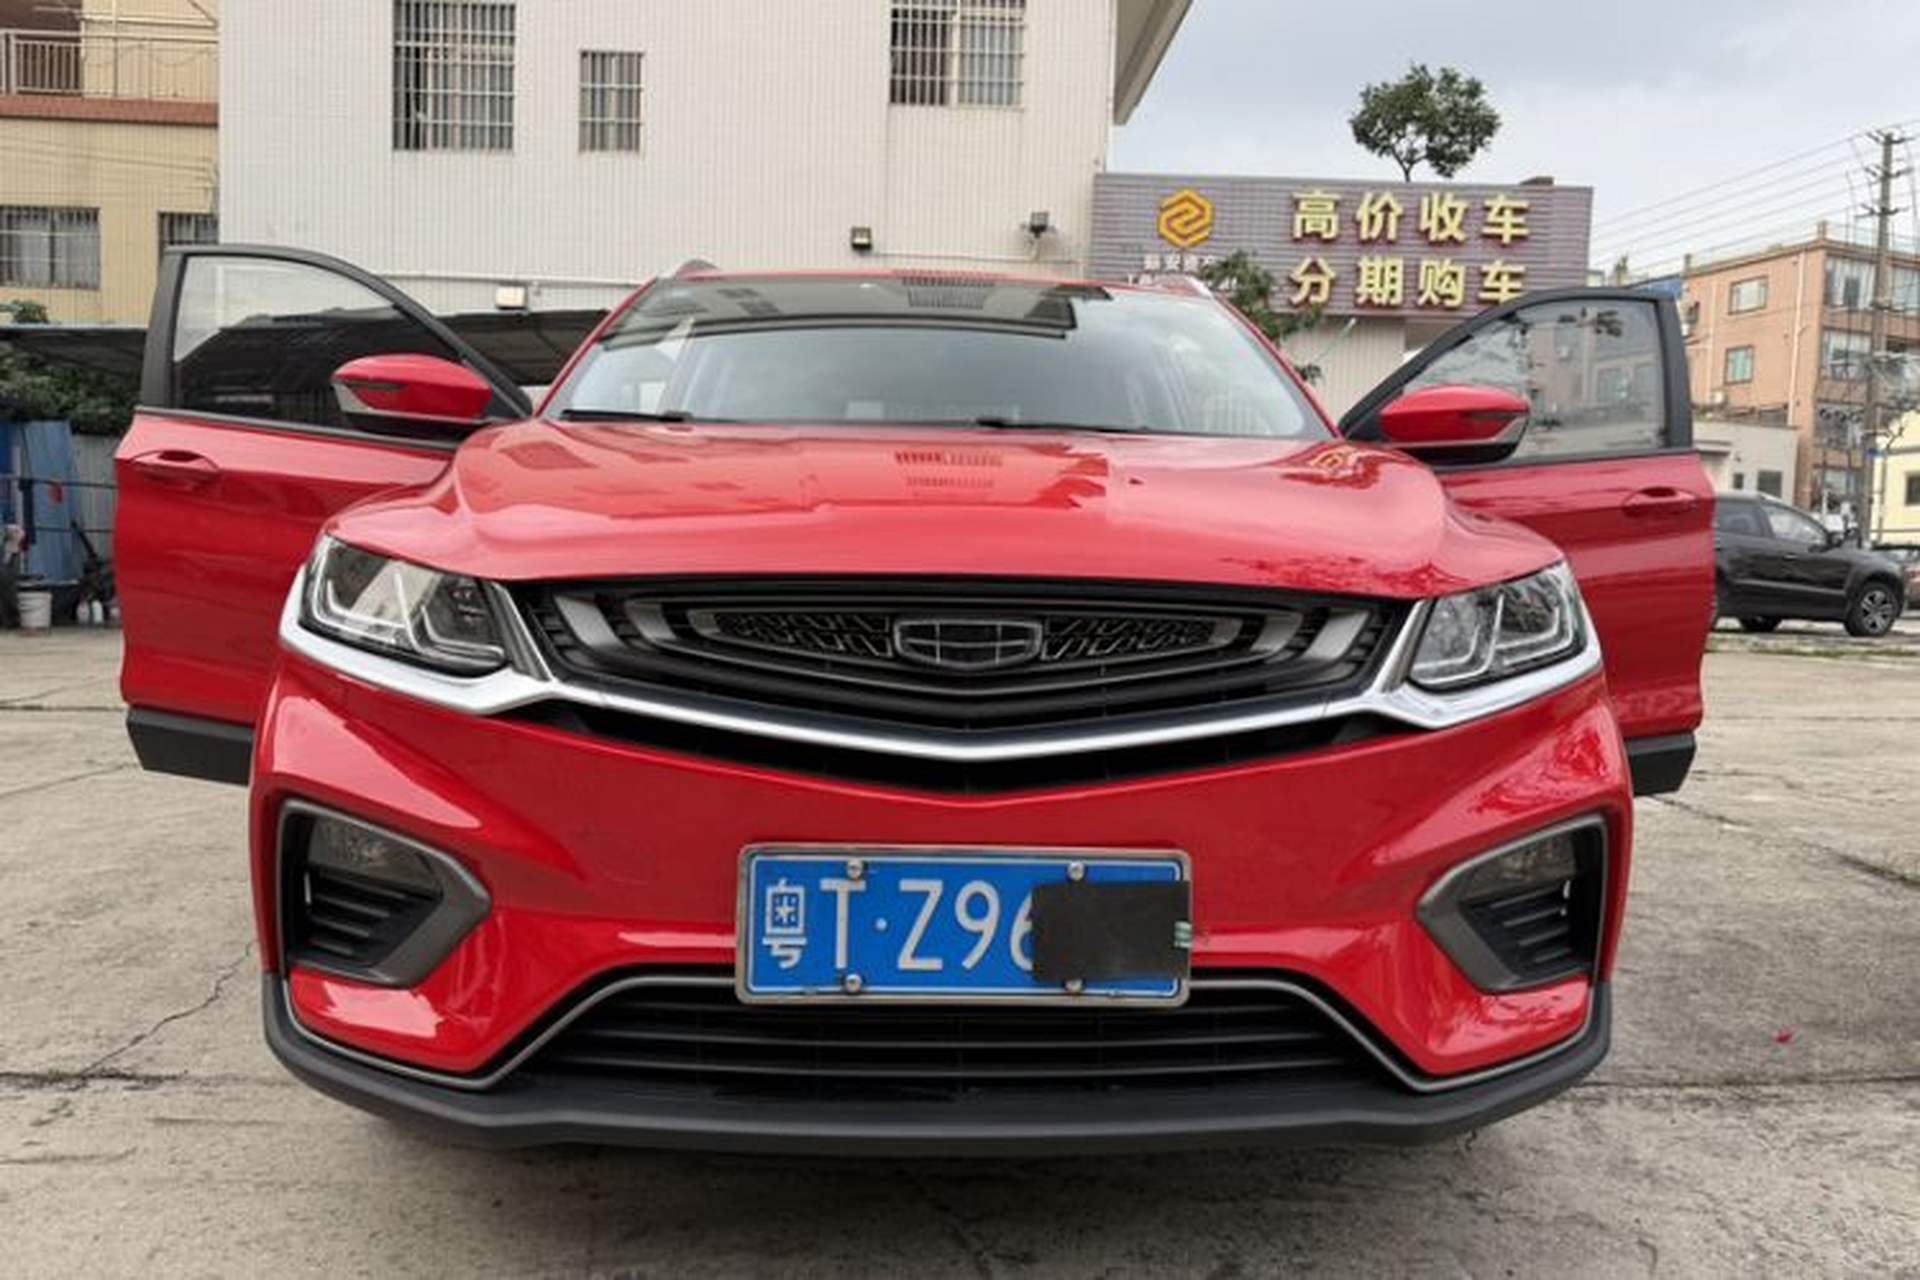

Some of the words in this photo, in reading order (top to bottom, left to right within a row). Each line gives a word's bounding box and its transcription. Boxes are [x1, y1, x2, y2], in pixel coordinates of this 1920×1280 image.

[1293, 190, 1529, 243] 高价收车
[1290, 257, 1525, 305] 分期购车
